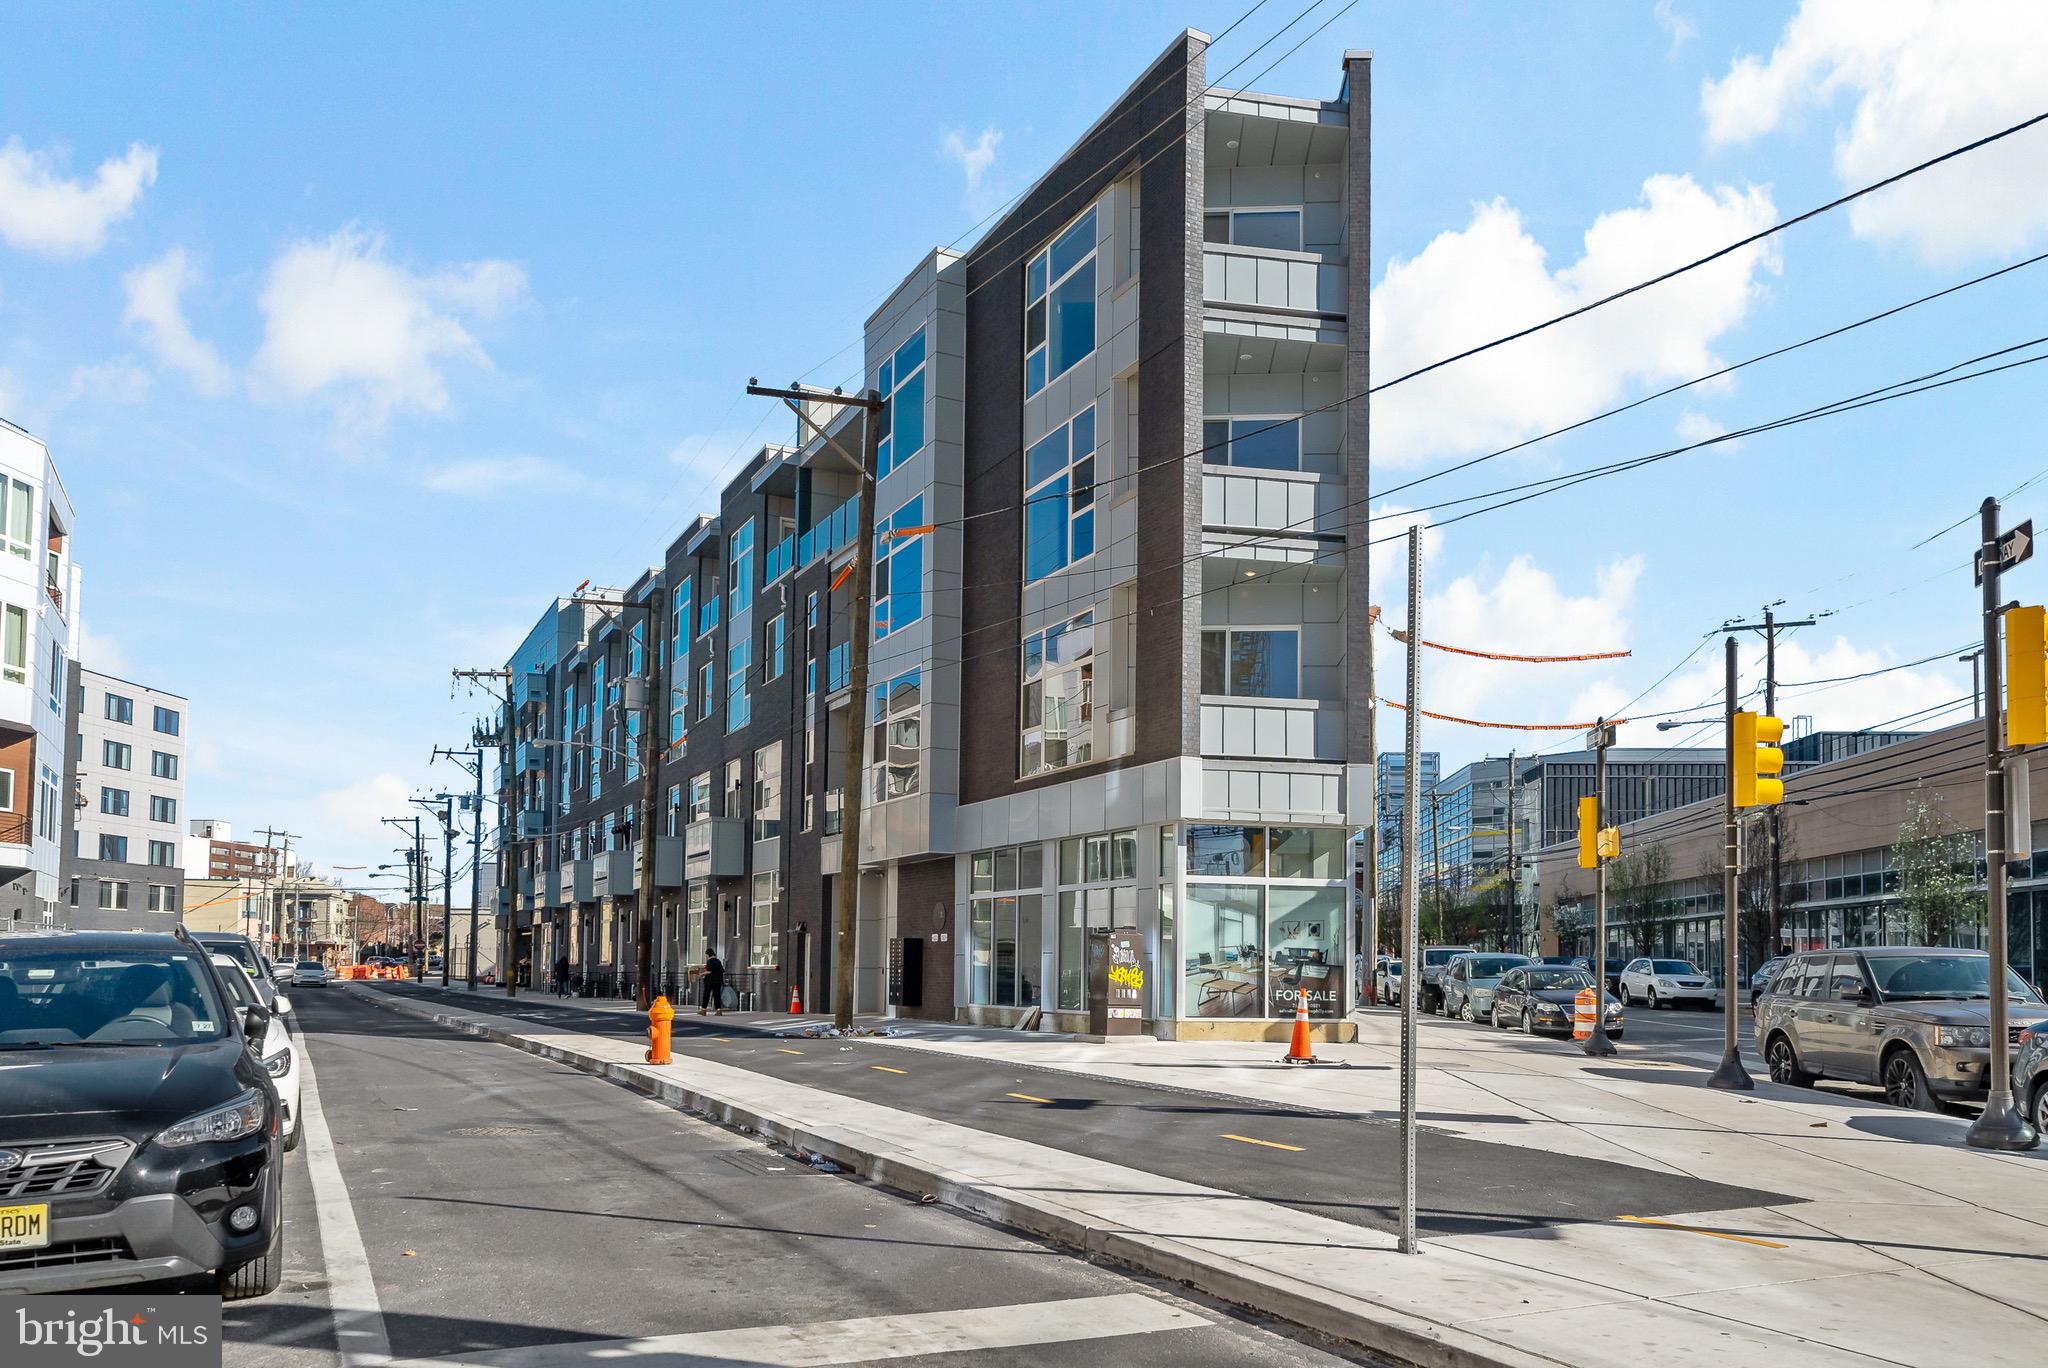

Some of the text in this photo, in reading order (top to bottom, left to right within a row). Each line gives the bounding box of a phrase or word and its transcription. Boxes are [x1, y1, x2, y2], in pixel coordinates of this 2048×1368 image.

[1276, 990, 1337, 1001] FOR SALE
[2, 1214, 40, 1238] RDM
